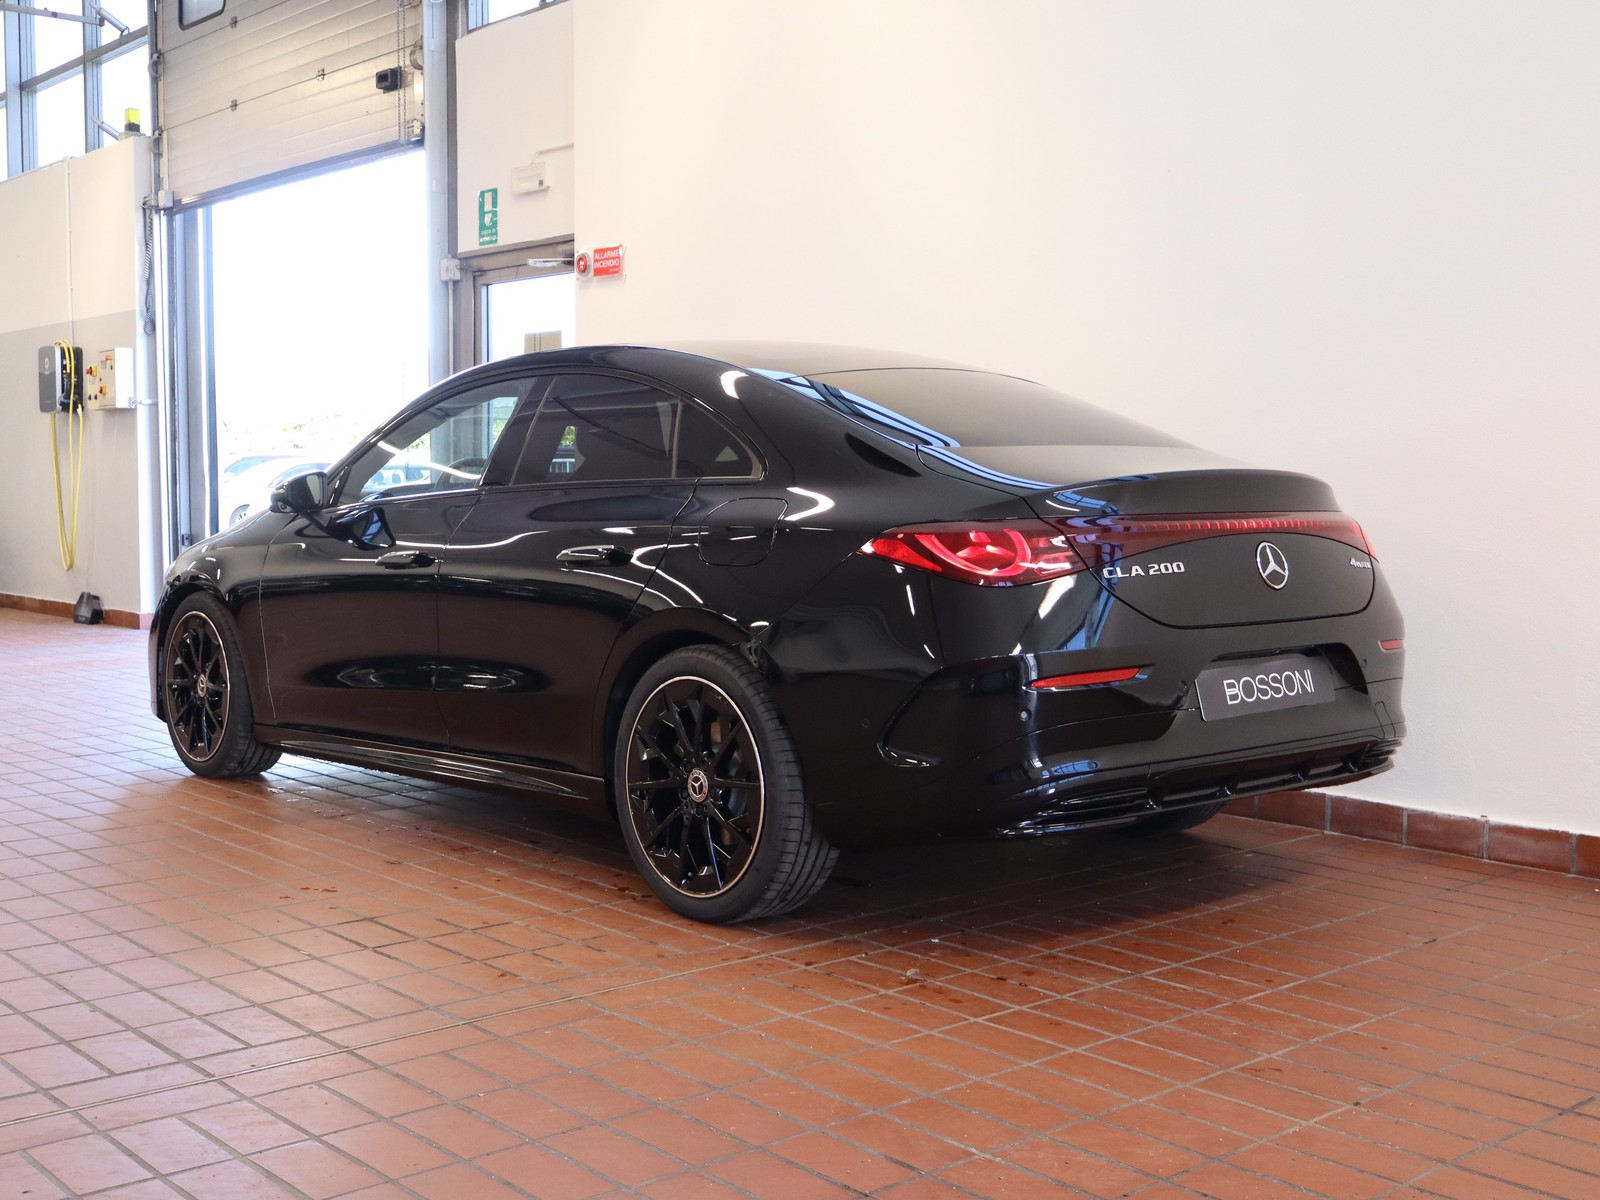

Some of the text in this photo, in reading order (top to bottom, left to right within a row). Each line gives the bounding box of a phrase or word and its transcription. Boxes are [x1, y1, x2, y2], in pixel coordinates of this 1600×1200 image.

[594, 250, 619, 259] ALLARME
[593, 259, 620, 268] INCENDIO
[1102, 561, 1185, 579] CLA 200
[1223, 669, 1315, 705] BOSSONI
